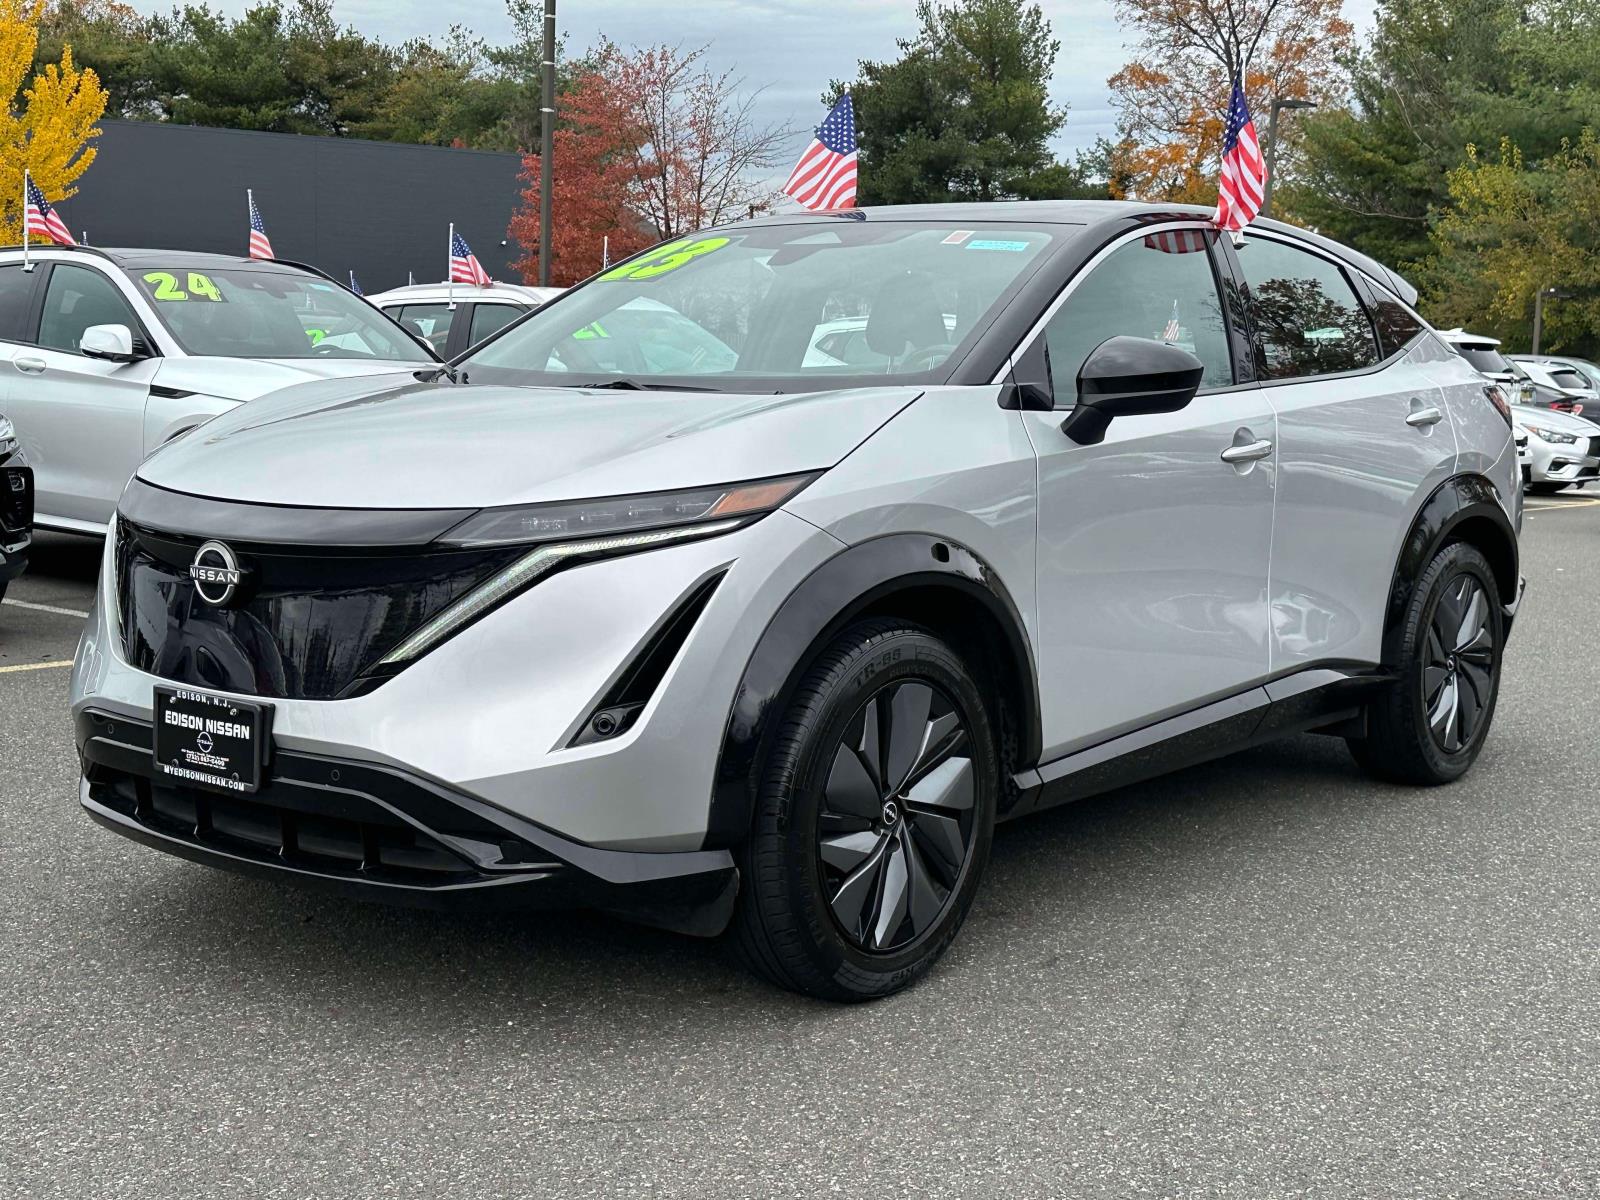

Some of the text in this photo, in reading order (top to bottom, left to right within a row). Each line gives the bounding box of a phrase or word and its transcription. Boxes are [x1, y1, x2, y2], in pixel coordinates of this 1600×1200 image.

[143, 272, 222, 302] 24
[189, 566, 238, 583] NISSAN
[176, 690, 231, 708] EDISON, N.J.
[164, 709, 250, 740] EDISON NISSAN
[163, 764, 245, 792] MYEDISONNISSAN.COM
